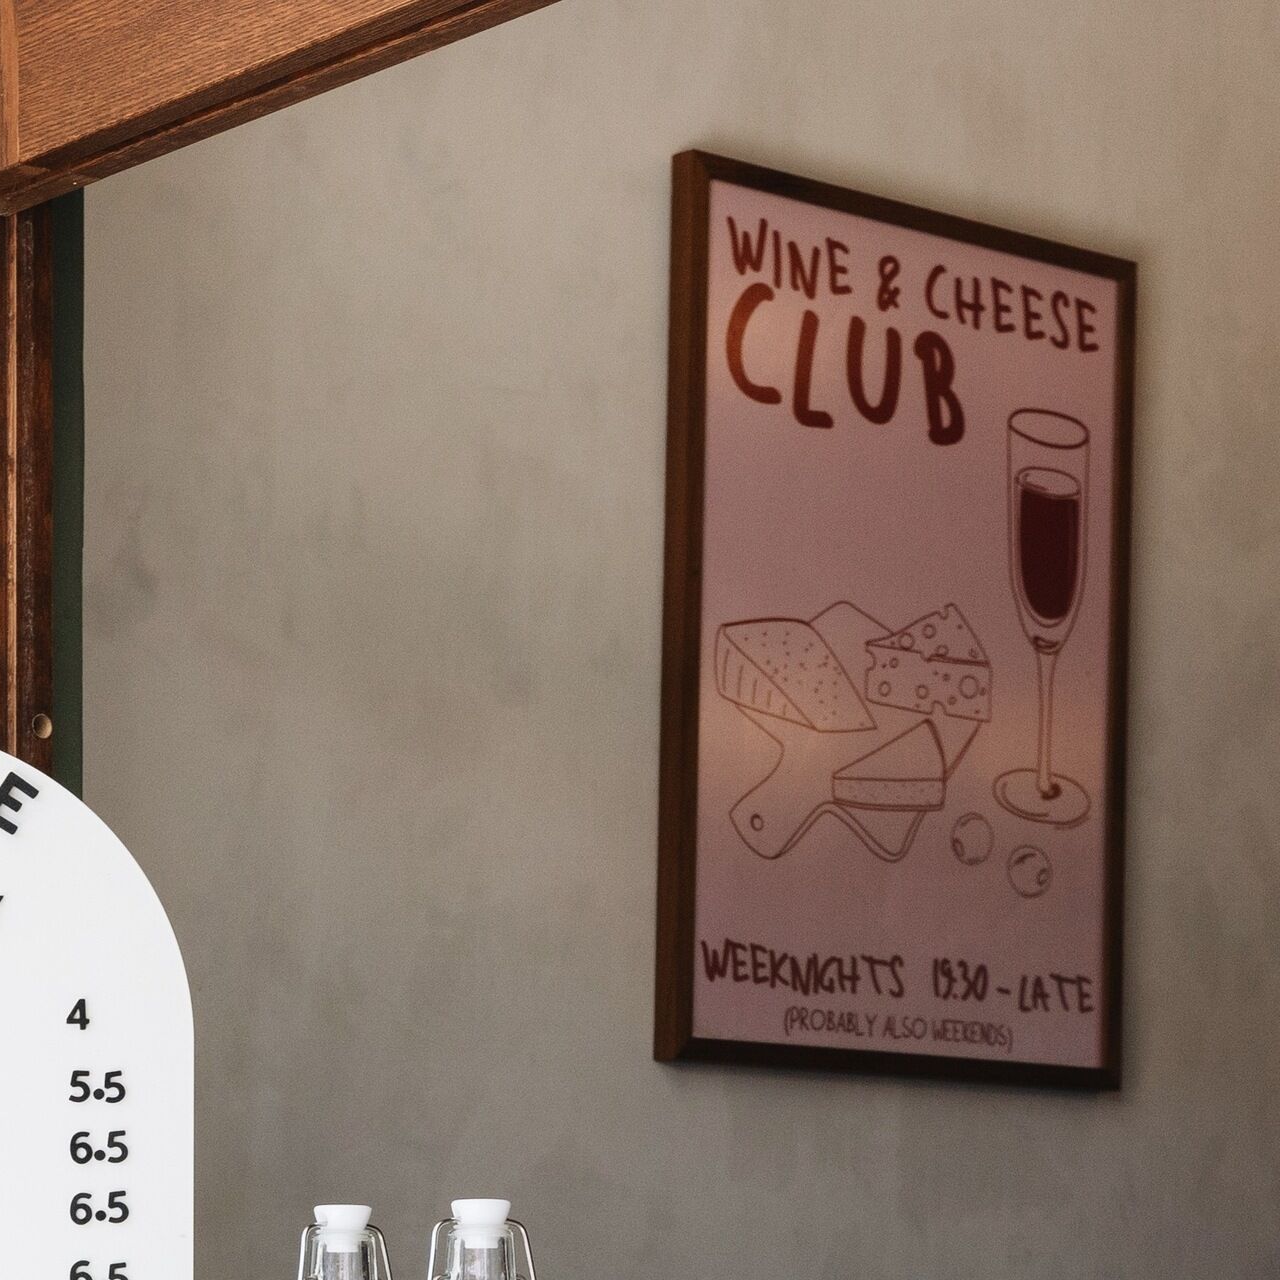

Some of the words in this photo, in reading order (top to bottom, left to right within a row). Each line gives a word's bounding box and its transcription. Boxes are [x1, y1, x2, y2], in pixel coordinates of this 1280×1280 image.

[727, 216, 853, 300] WINE
[877, 255, 901, 312] &
[924, 265, 1100, 353] CHEESE
[725, 282, 966, 446] CLUB
[701, 938, 905, 998] WEEKNIGHTS
[1018, 973, 1095, 1014] LATE
[67, 999, 90, 1030] 4
[883, 1014, 928, 1040] ALSO
[69, 1071, 126, 1103] 5.5
[70, 1131, 128, 1164] 6.5
[70, 1191, 129, 1225] 6.5
